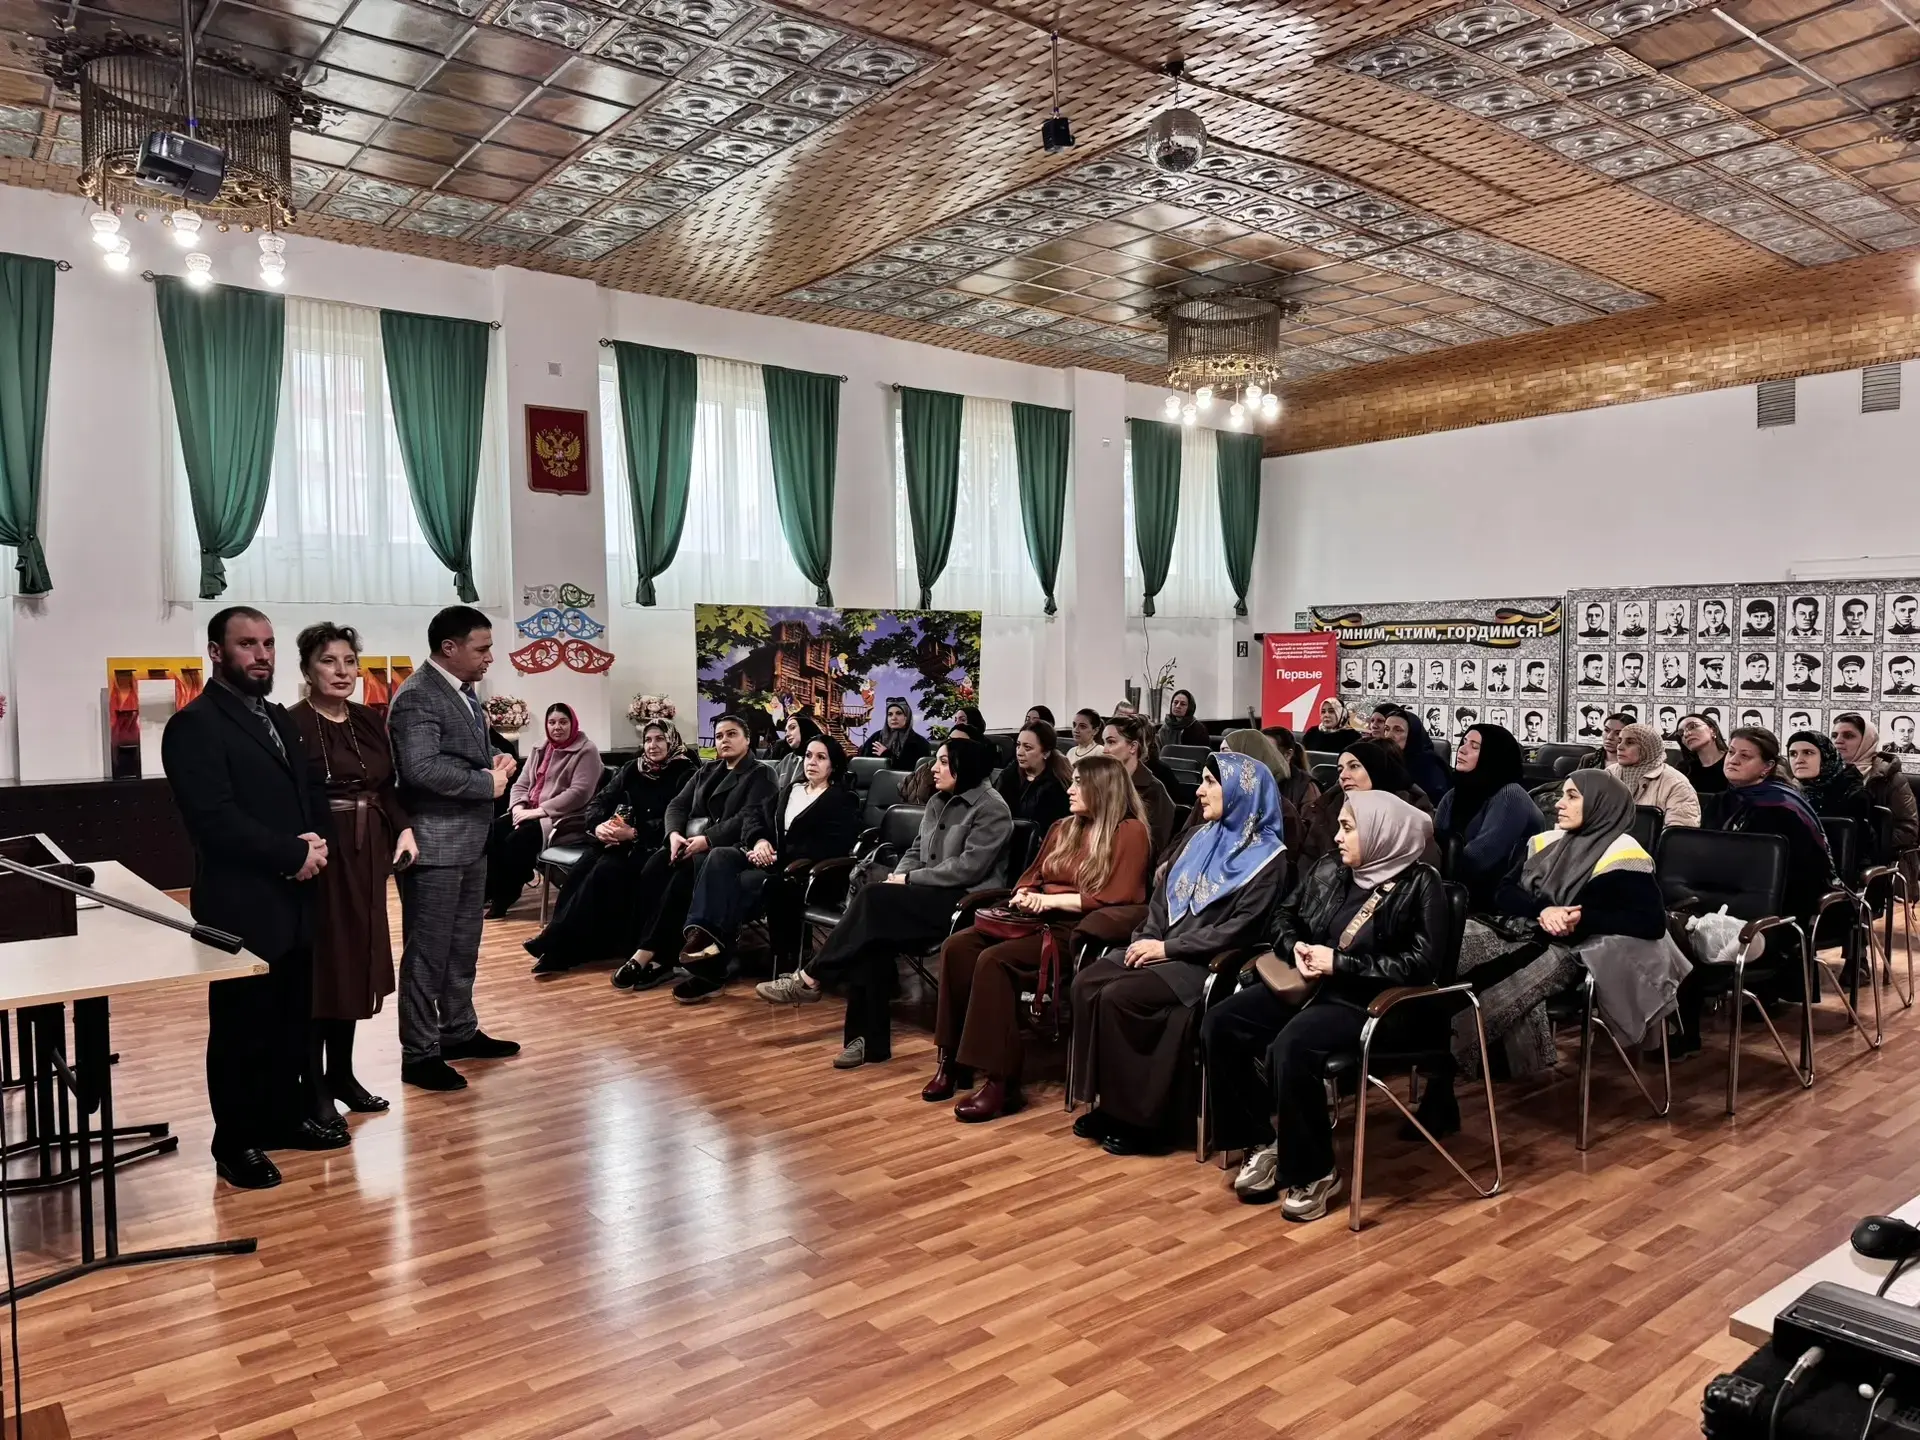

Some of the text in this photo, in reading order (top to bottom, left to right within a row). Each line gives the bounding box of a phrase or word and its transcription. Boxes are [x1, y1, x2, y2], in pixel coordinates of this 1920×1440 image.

[1395, 627, 1442, 641] чтим,
[1447, 620, 1543, 642] гордимся!
[1276, 668, 1322, 682] Первые
